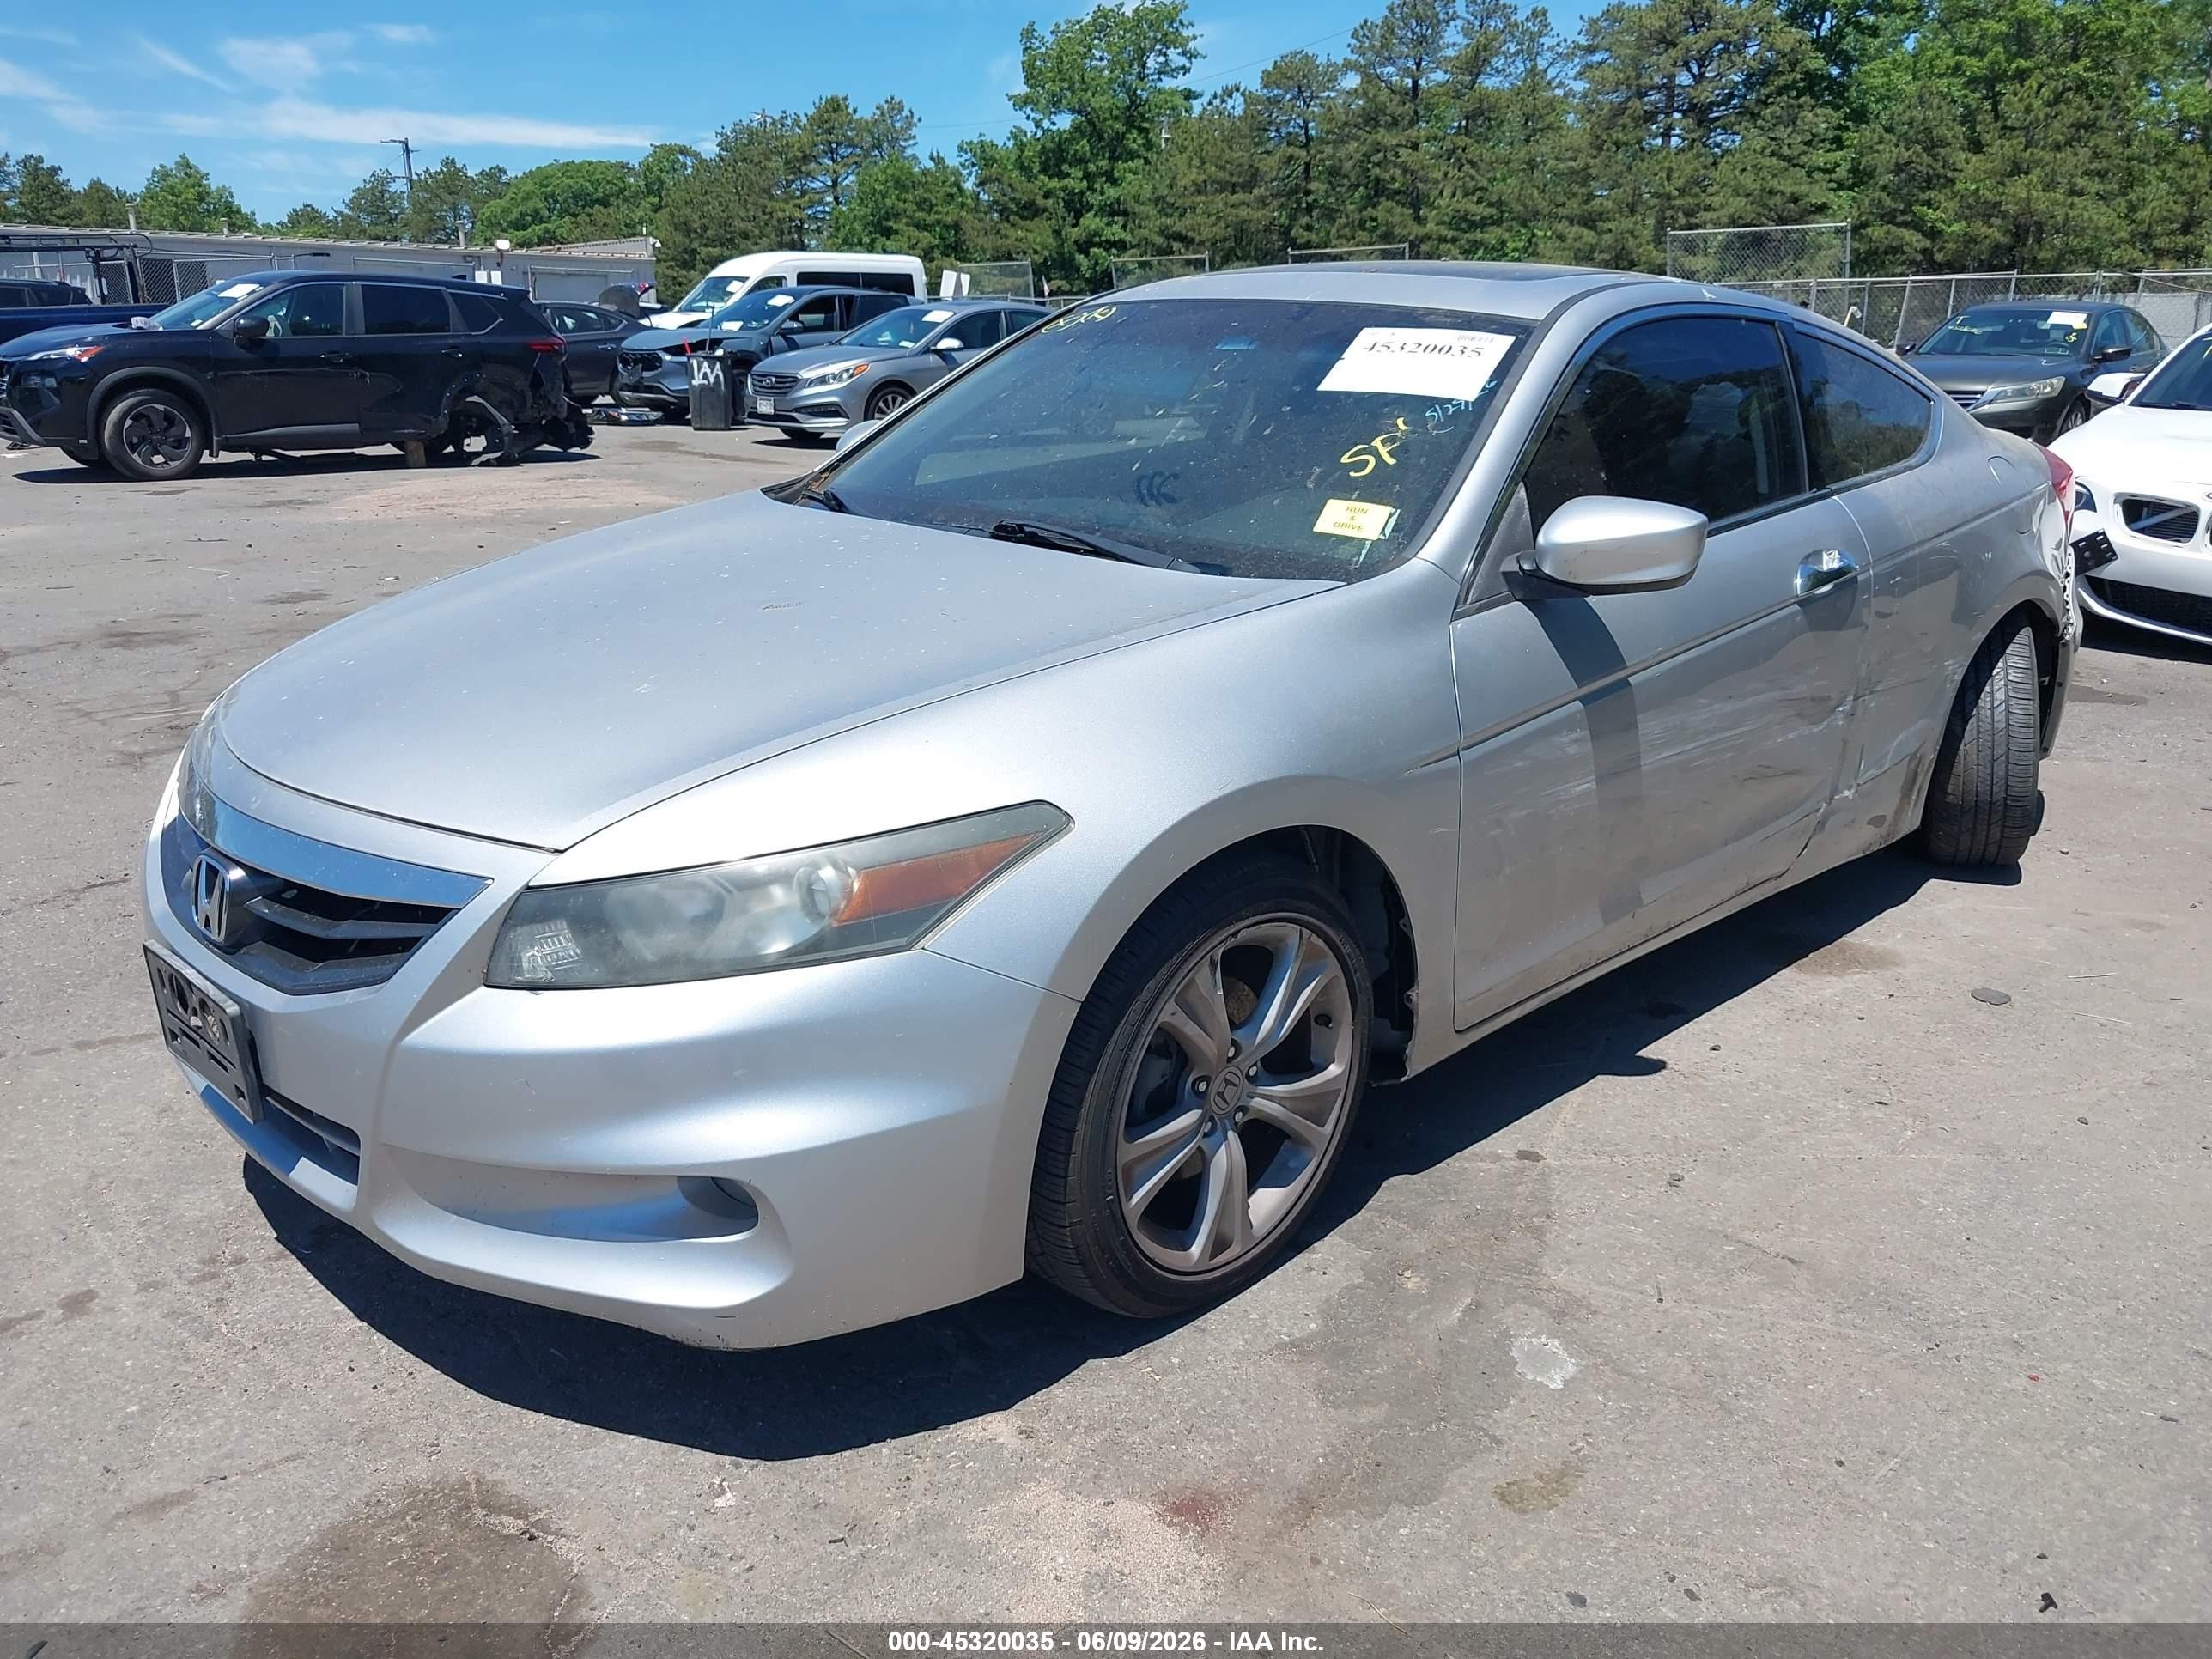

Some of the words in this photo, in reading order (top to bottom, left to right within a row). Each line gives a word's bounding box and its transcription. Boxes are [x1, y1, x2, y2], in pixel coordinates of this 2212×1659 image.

[1363, 341, 1485, 358] 45320035
[1346, 506, 1369, 514] RUN
[1333, 521, 1365, 531] DRIVE
